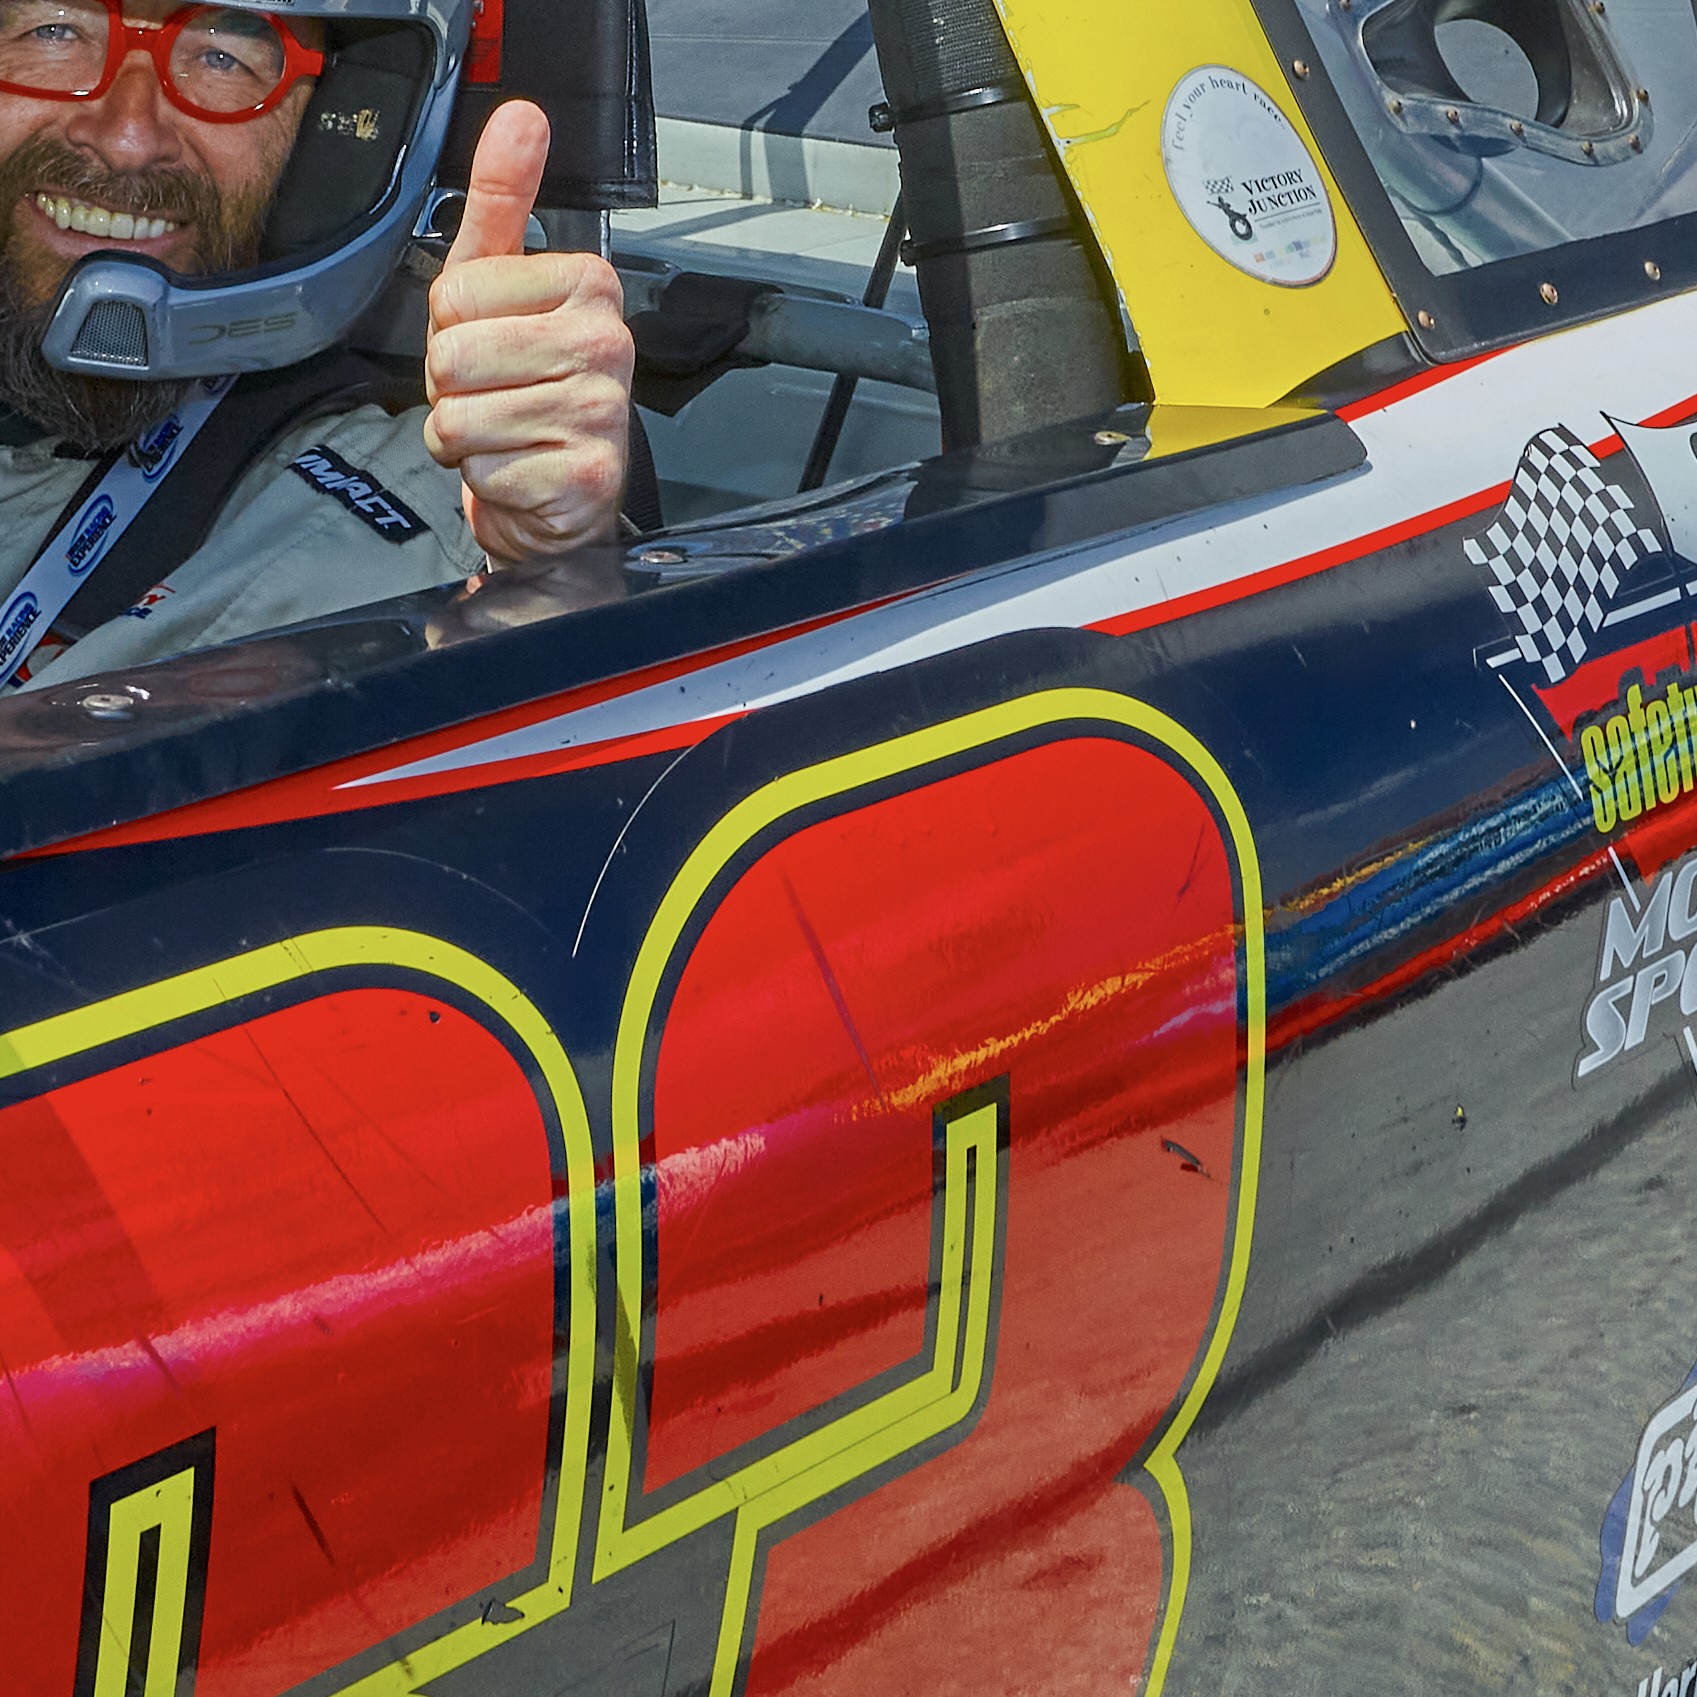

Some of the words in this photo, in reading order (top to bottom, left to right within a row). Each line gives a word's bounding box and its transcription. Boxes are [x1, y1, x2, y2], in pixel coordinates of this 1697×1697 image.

[1208, 75, 1249, 96] heart
[1241, 168, 1305, 197] VICTORY
[1247, 184, 1318, 216] JUNCTION
[293, 454, 412, 529] IMPACT
[68, 513, 118, 569] EXPERIENCE
